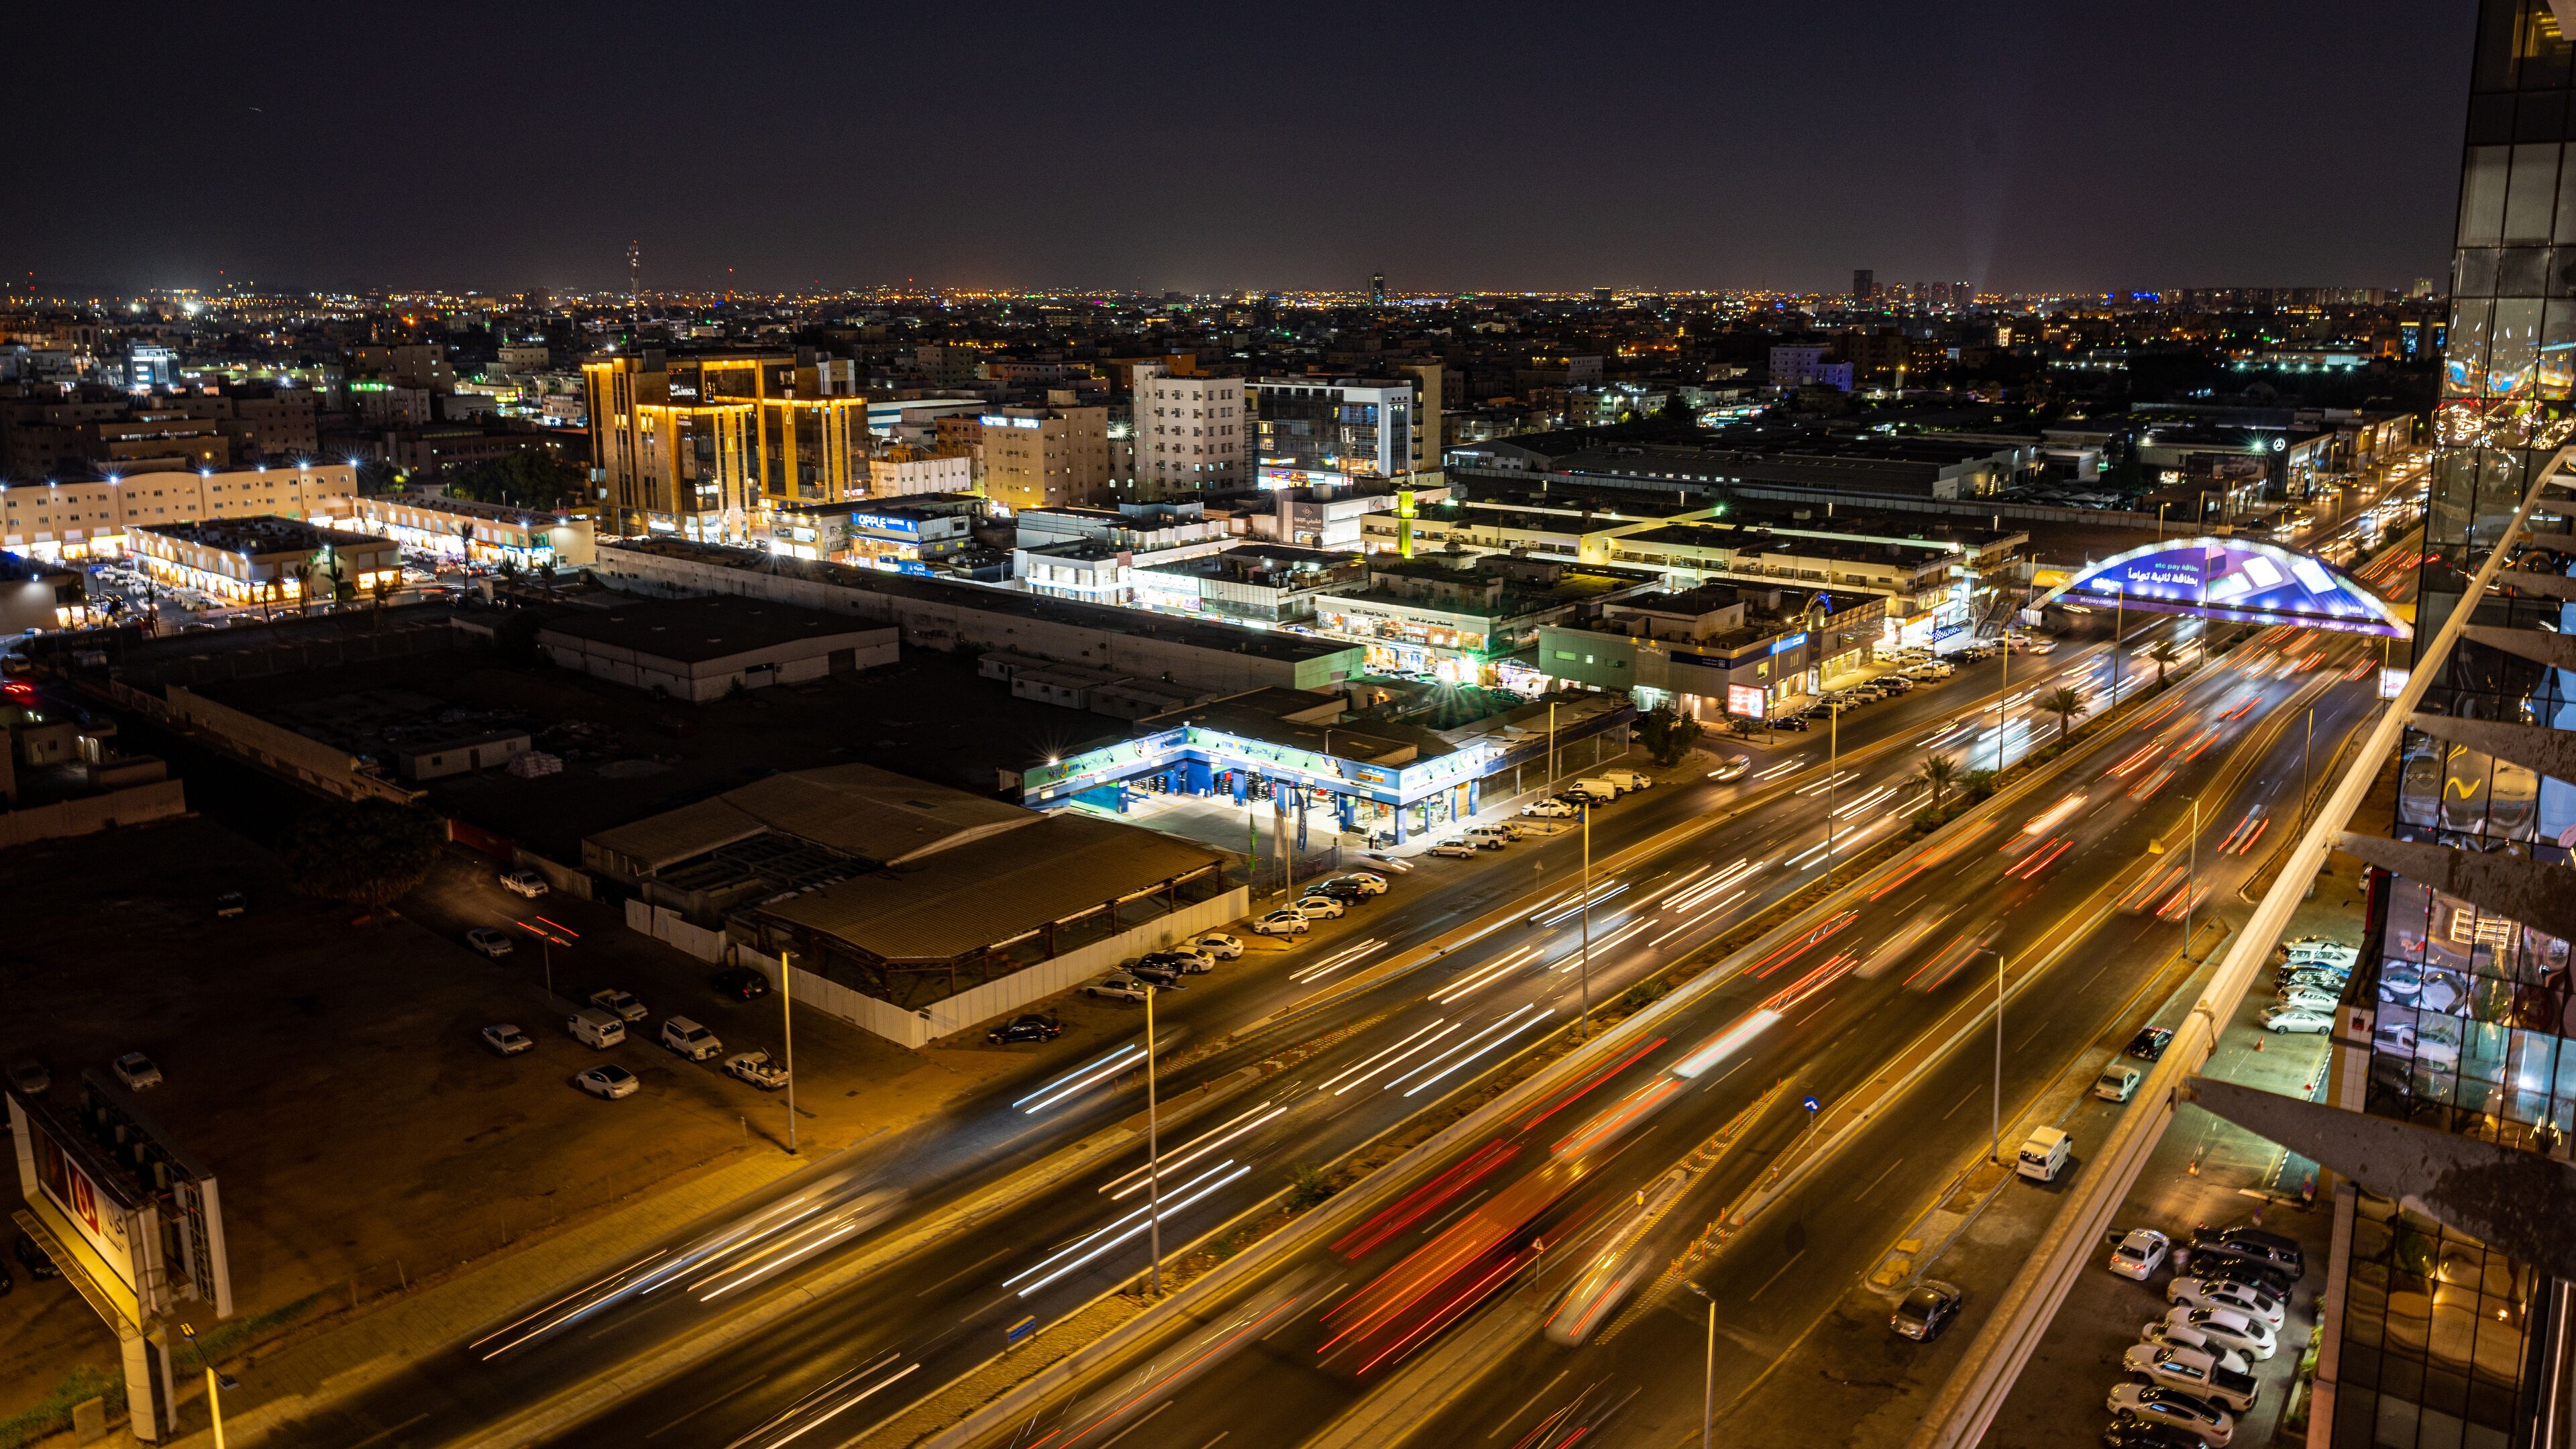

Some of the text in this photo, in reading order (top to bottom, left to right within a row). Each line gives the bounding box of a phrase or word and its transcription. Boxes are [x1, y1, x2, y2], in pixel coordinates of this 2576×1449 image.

[858, 515, 886, 529] OPPLE
[2151, 571, 2171, 584] ثانية
[2171, 572, 2199, 587] بطاقة
[2348, 605, 2364, 614] VISA
